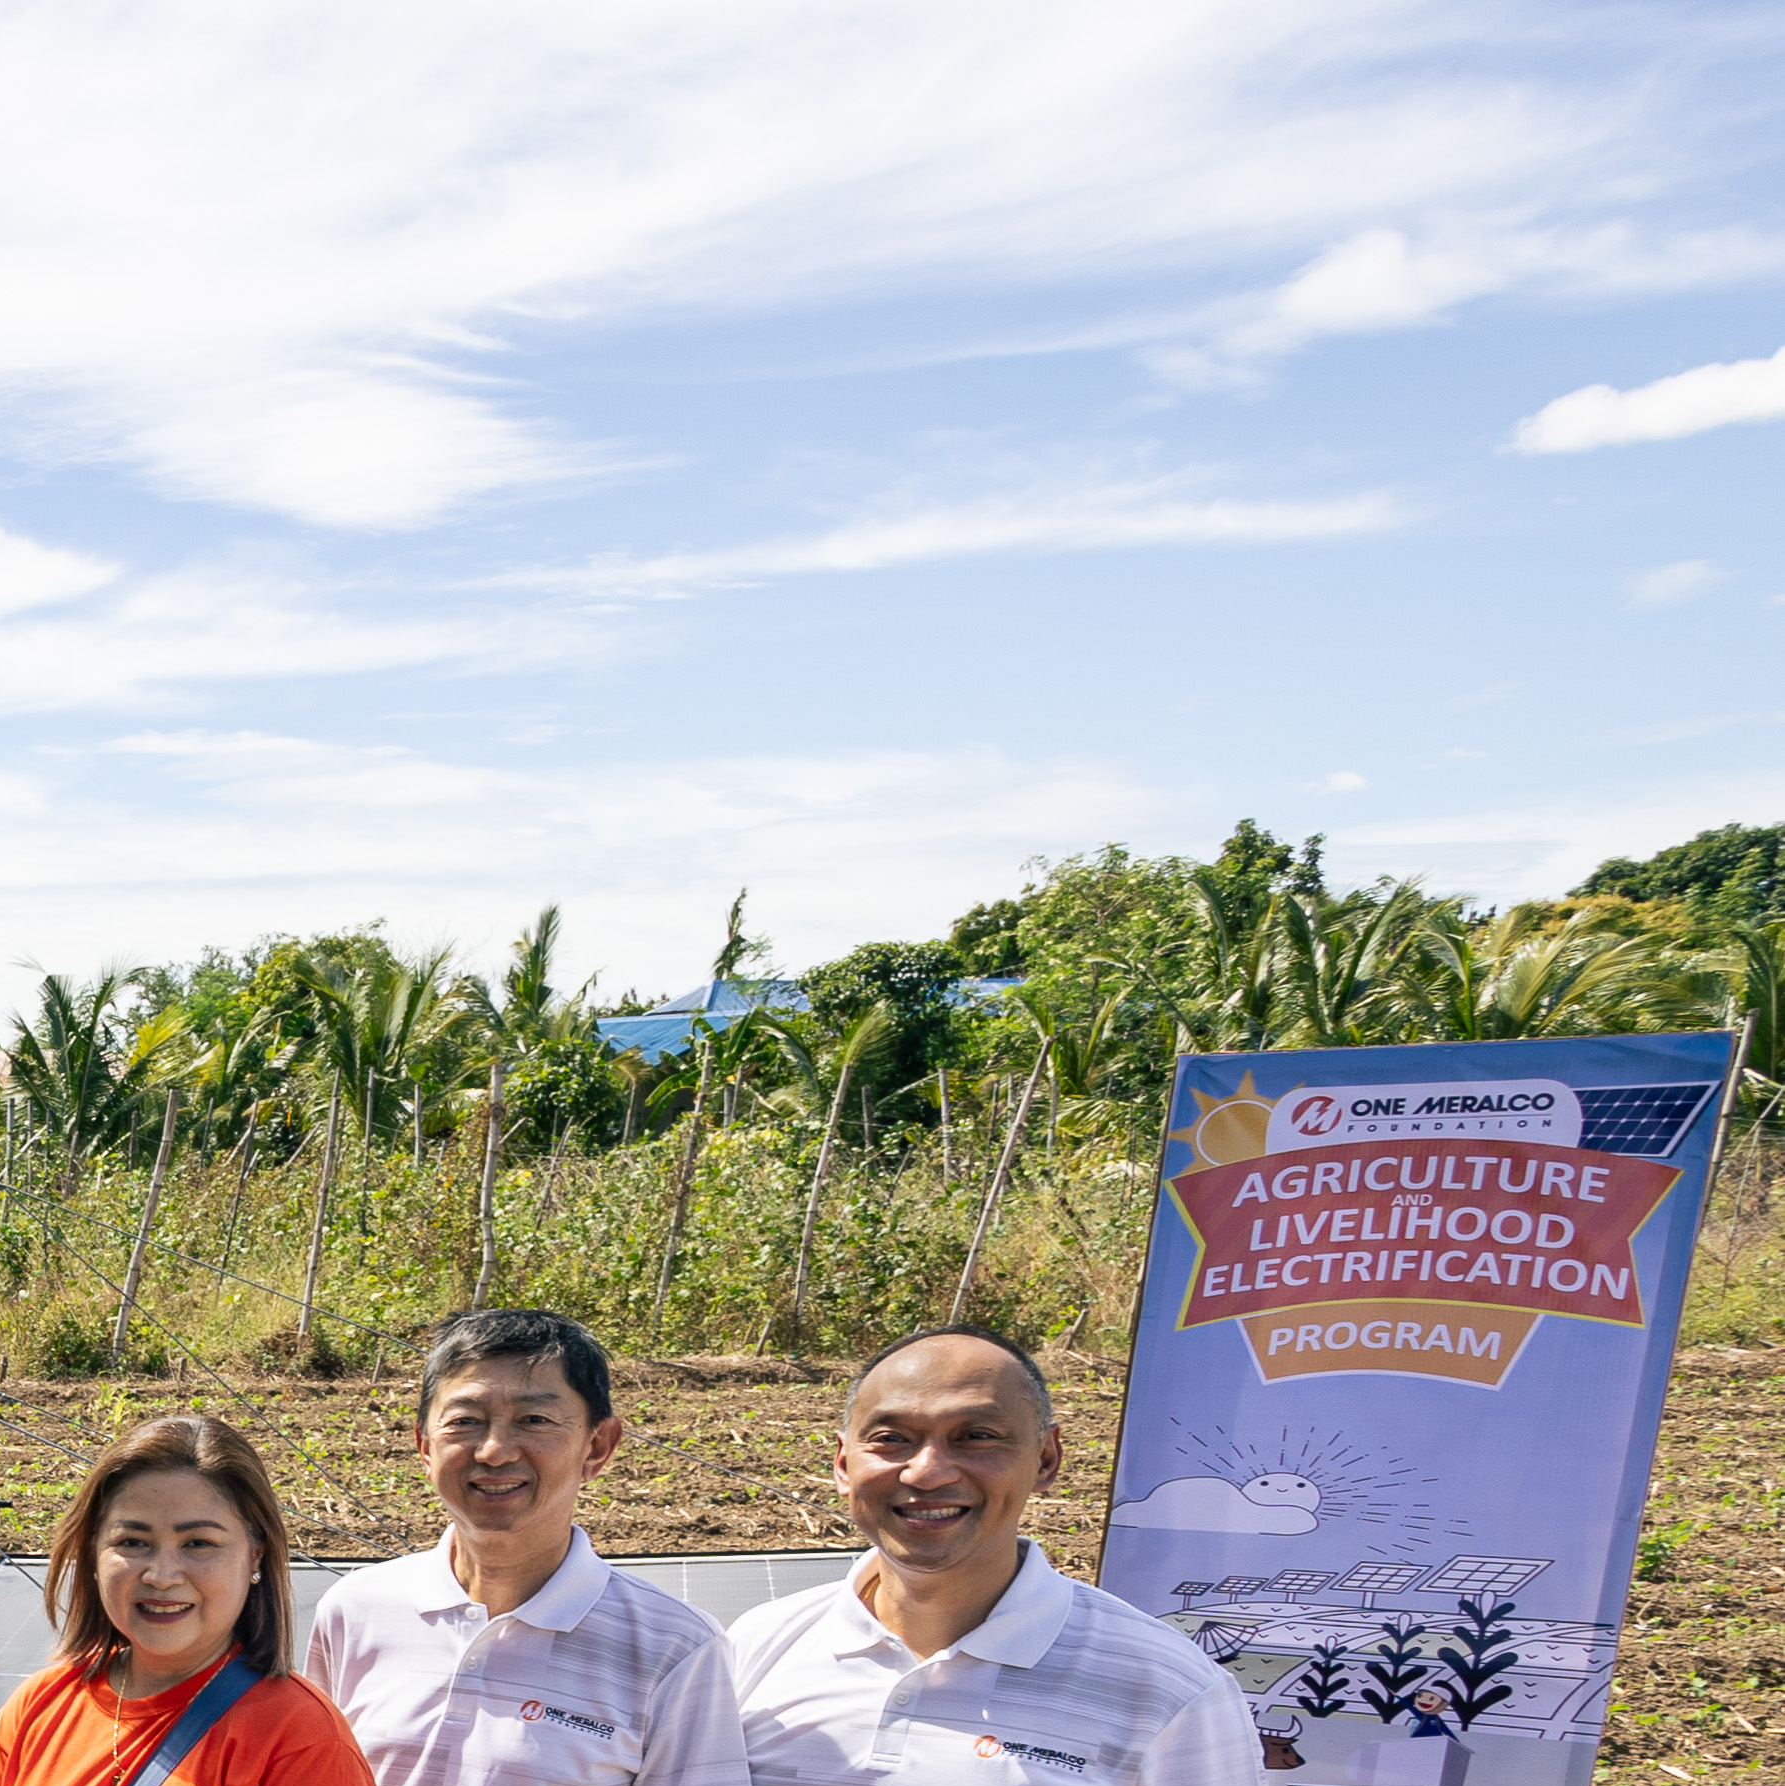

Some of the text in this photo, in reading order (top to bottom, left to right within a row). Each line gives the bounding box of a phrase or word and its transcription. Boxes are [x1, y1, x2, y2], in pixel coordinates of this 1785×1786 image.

[1350, 1098, 1405, 1117] ONE
[1412, 1092, 1555, 1115] MERALCO
[1348, 1118, 1552, 1134] FOUNDATION
[1232, 1155, 1610, 1208] AGRICULTURE
[1391, 1193, 1433, 1207] AND
[1250, 1205, 1574, 1251] LIVELIHOOD
[1202, 1249, 1630, 1300] ELECTRIFICATION
[1267, 1320, 1502, 1360] PROGRAM
[545, 1707, 567, 1718] ONE
[568, 1715, 615, 1734] MERALCO
[1002, 1741, 1029, 1752] ONE
[1029, 1747, 1086, 1766] MERALCO
